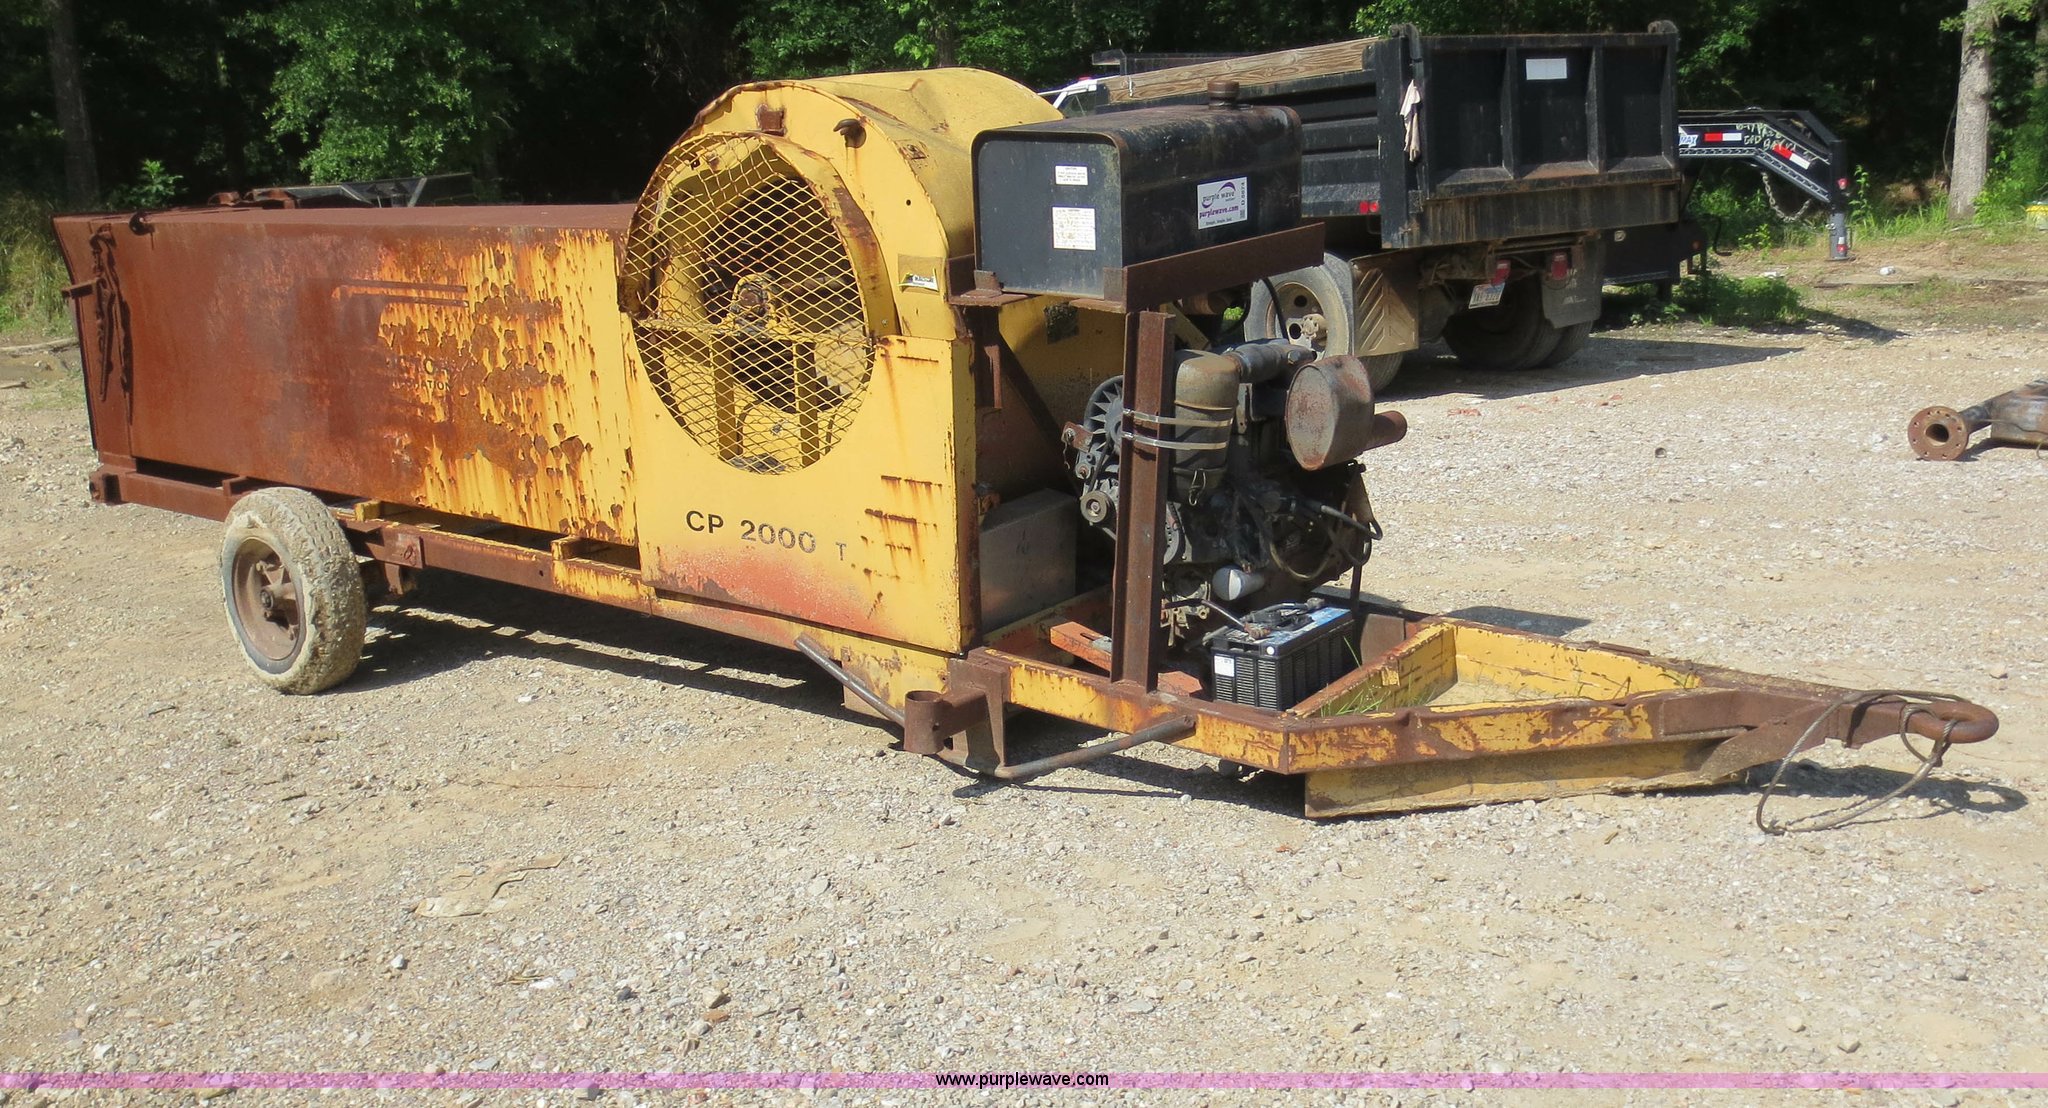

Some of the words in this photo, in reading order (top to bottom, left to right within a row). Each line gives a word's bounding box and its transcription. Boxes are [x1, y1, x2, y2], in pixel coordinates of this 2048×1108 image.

[1203, 193, 1219, 203] purple
[1200, 206, 1238, 219] purplewave.com
[686, 510, 724, 534] CP
[740, 519, 817, 554] 2000
[835, 541, 847, 561] T
